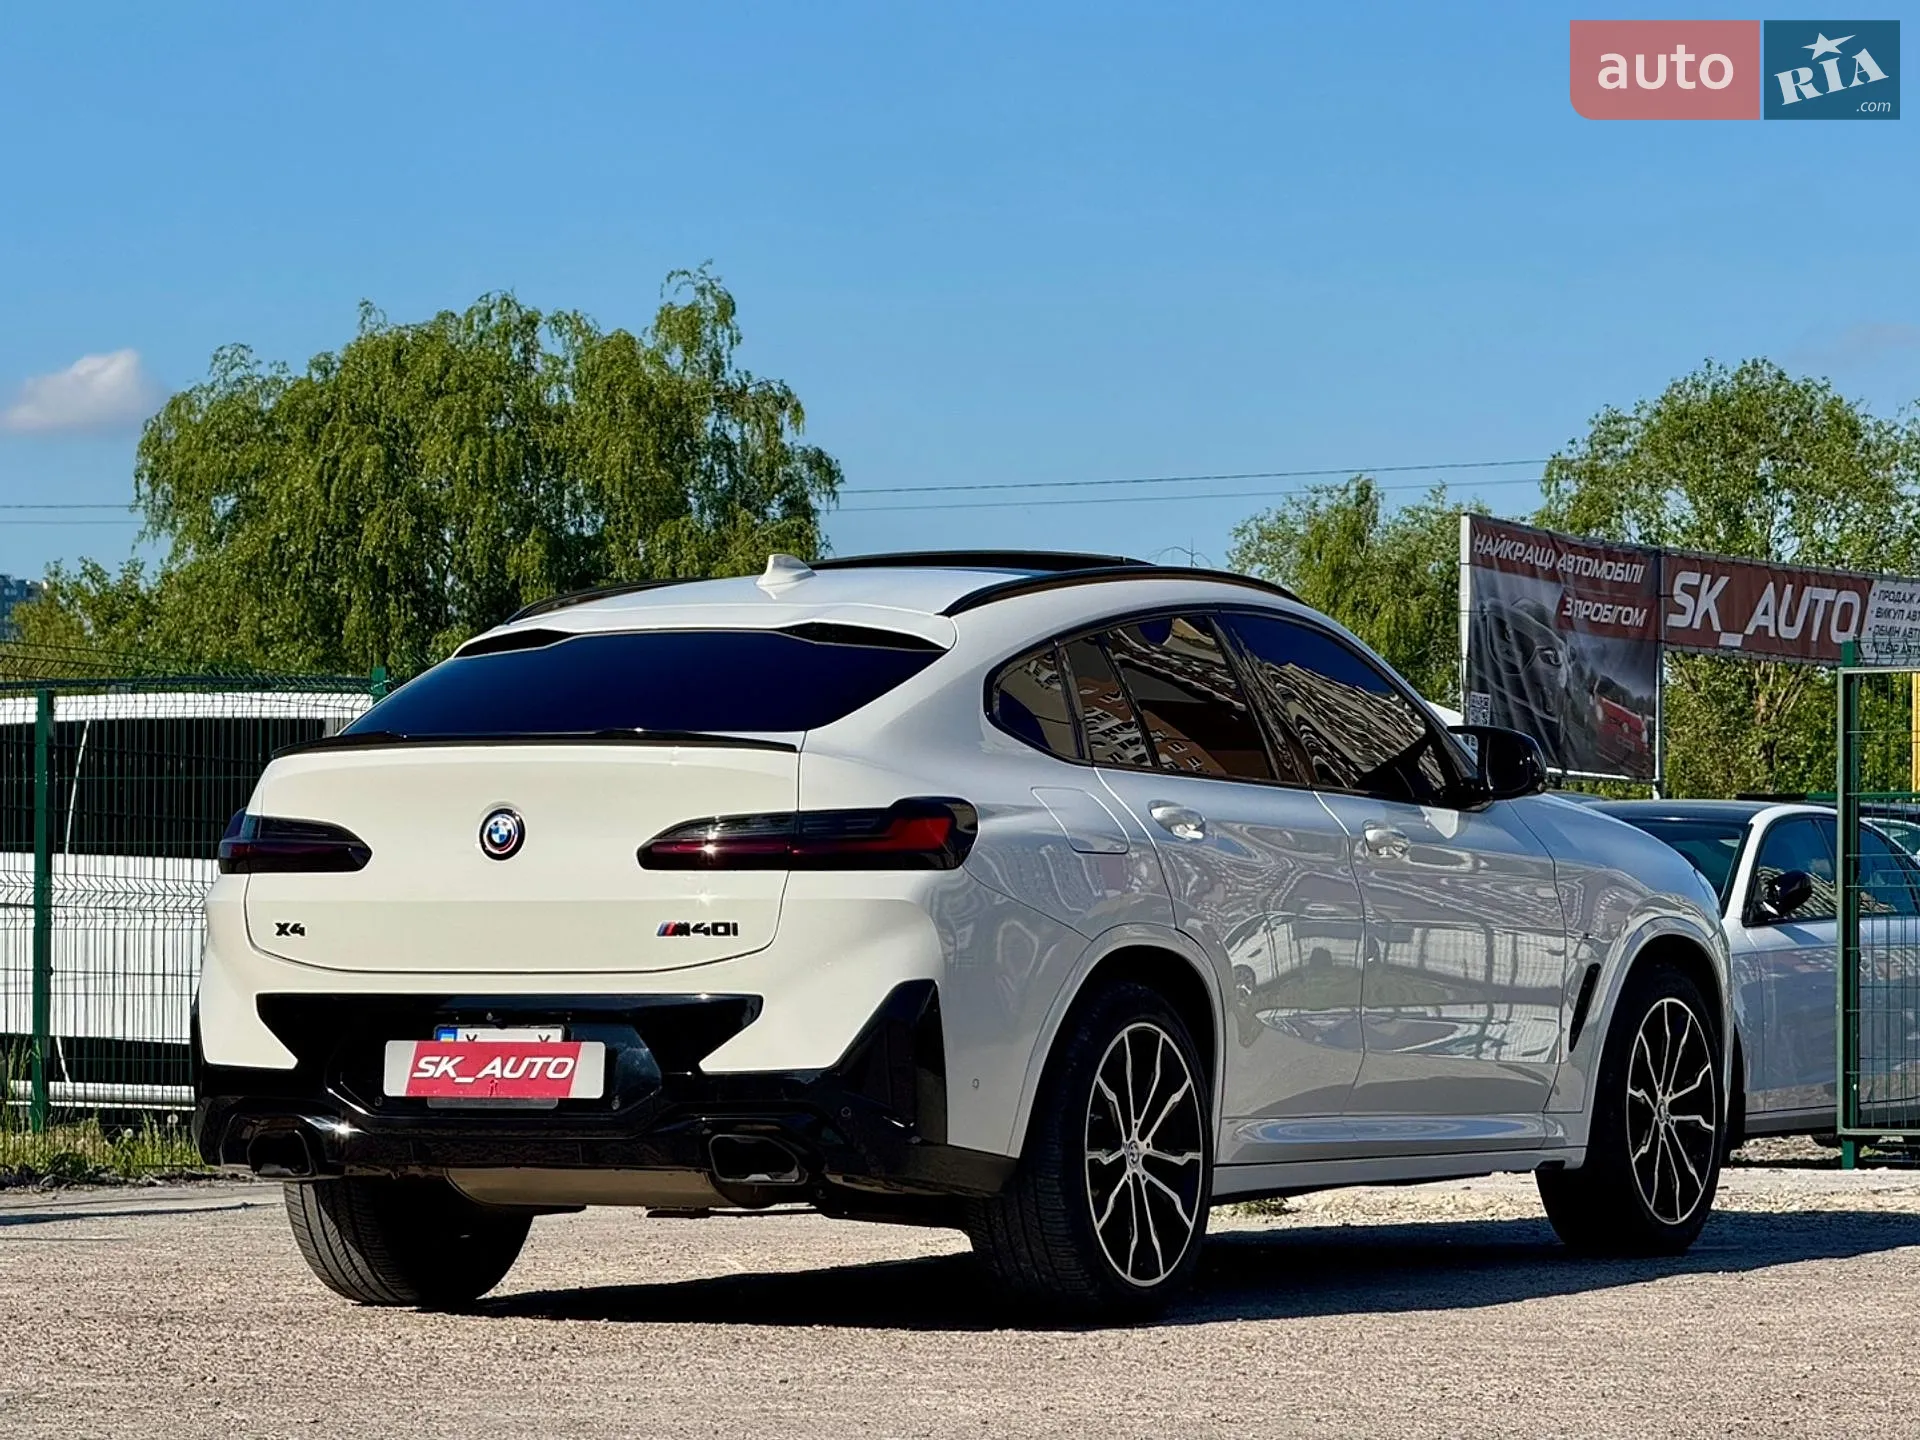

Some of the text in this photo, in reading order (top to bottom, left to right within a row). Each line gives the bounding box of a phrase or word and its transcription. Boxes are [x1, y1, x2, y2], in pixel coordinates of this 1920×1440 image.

[1473, 533, 1646, 584] НАЙКРАЩІ АВТОМОБІЛІ
[1666, 570, 1861, 648] SK_AUTO
[1877, 589, 1916, 605] ПРОДАЖ
[1562, 597, 1648, 628] З ПРОБІГОМ
[1875, 606, 1905, 620] ВИКУП
[275, 922, 305, 936] X4
[412, 1055, 575, 1083] SK_AUTO
